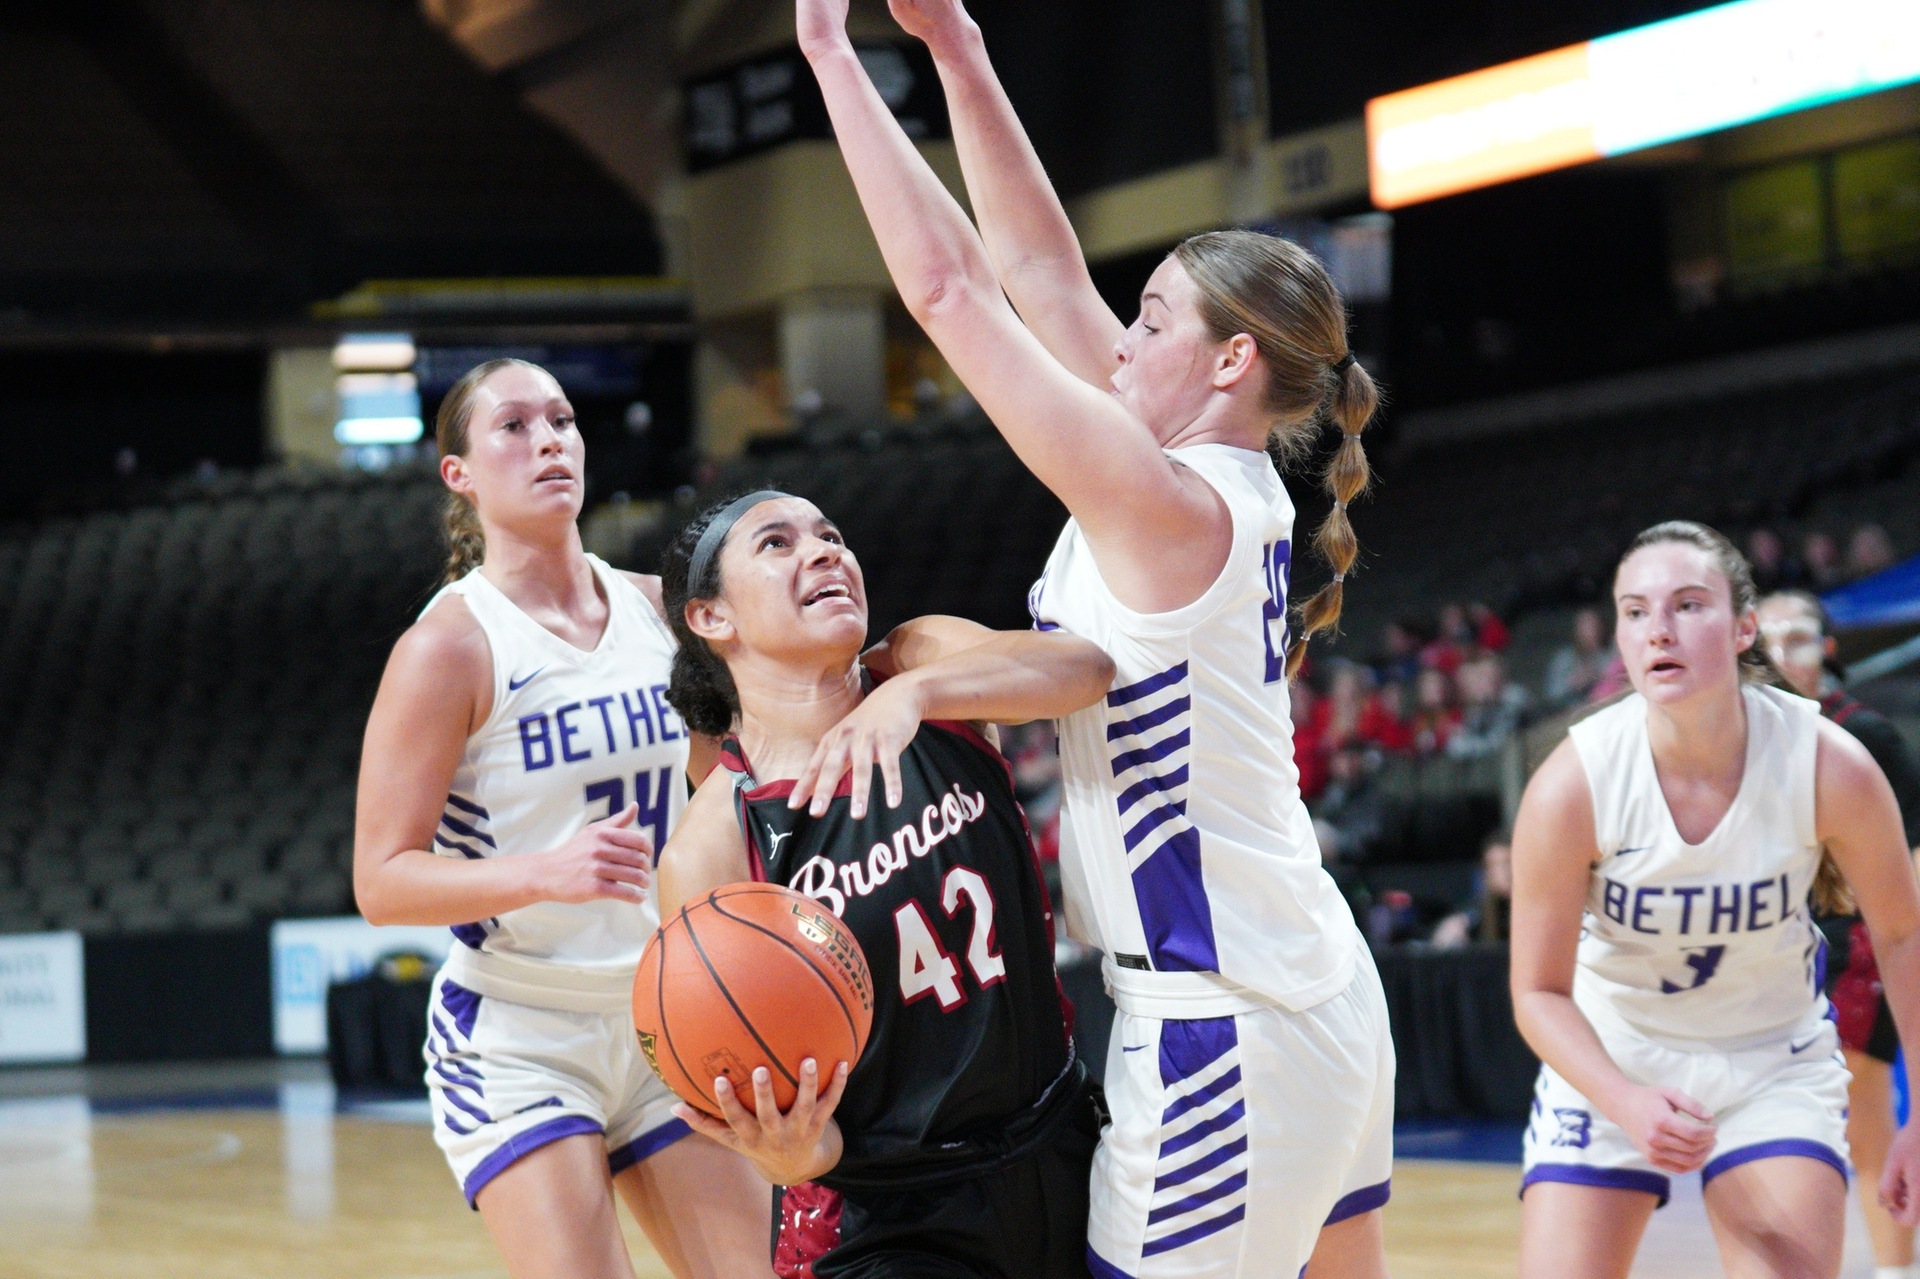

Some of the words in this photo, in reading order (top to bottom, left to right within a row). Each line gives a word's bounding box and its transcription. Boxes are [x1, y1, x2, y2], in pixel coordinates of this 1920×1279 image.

[519, 683, 690, 772] BETHE
[788, 782, 986, 920] Broncos
[791, 902, 873, 1000] LEGAC
[892, 864, 1007, 1013] 42
[1603, 873, 1797, 934] BETHEL
